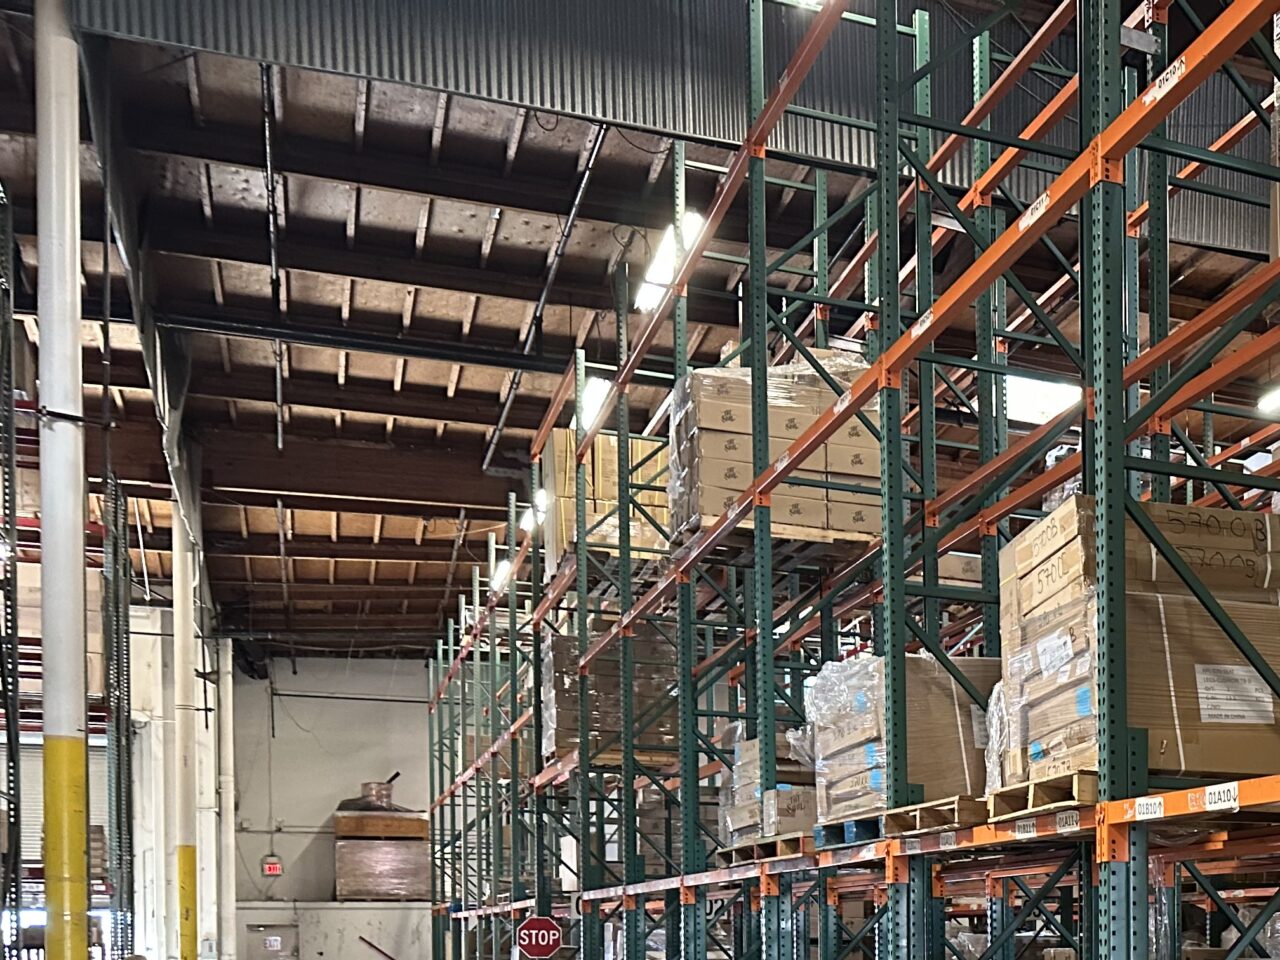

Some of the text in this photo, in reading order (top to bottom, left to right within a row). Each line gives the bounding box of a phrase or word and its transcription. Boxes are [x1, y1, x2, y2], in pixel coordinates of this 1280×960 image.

[1158, 66, 1177, 88] 01C10
[1208, 789, 1232, 806] 01A10
[1137, 801, 1158, 817] 01B10
[519, 927, 560, 947] STOP
